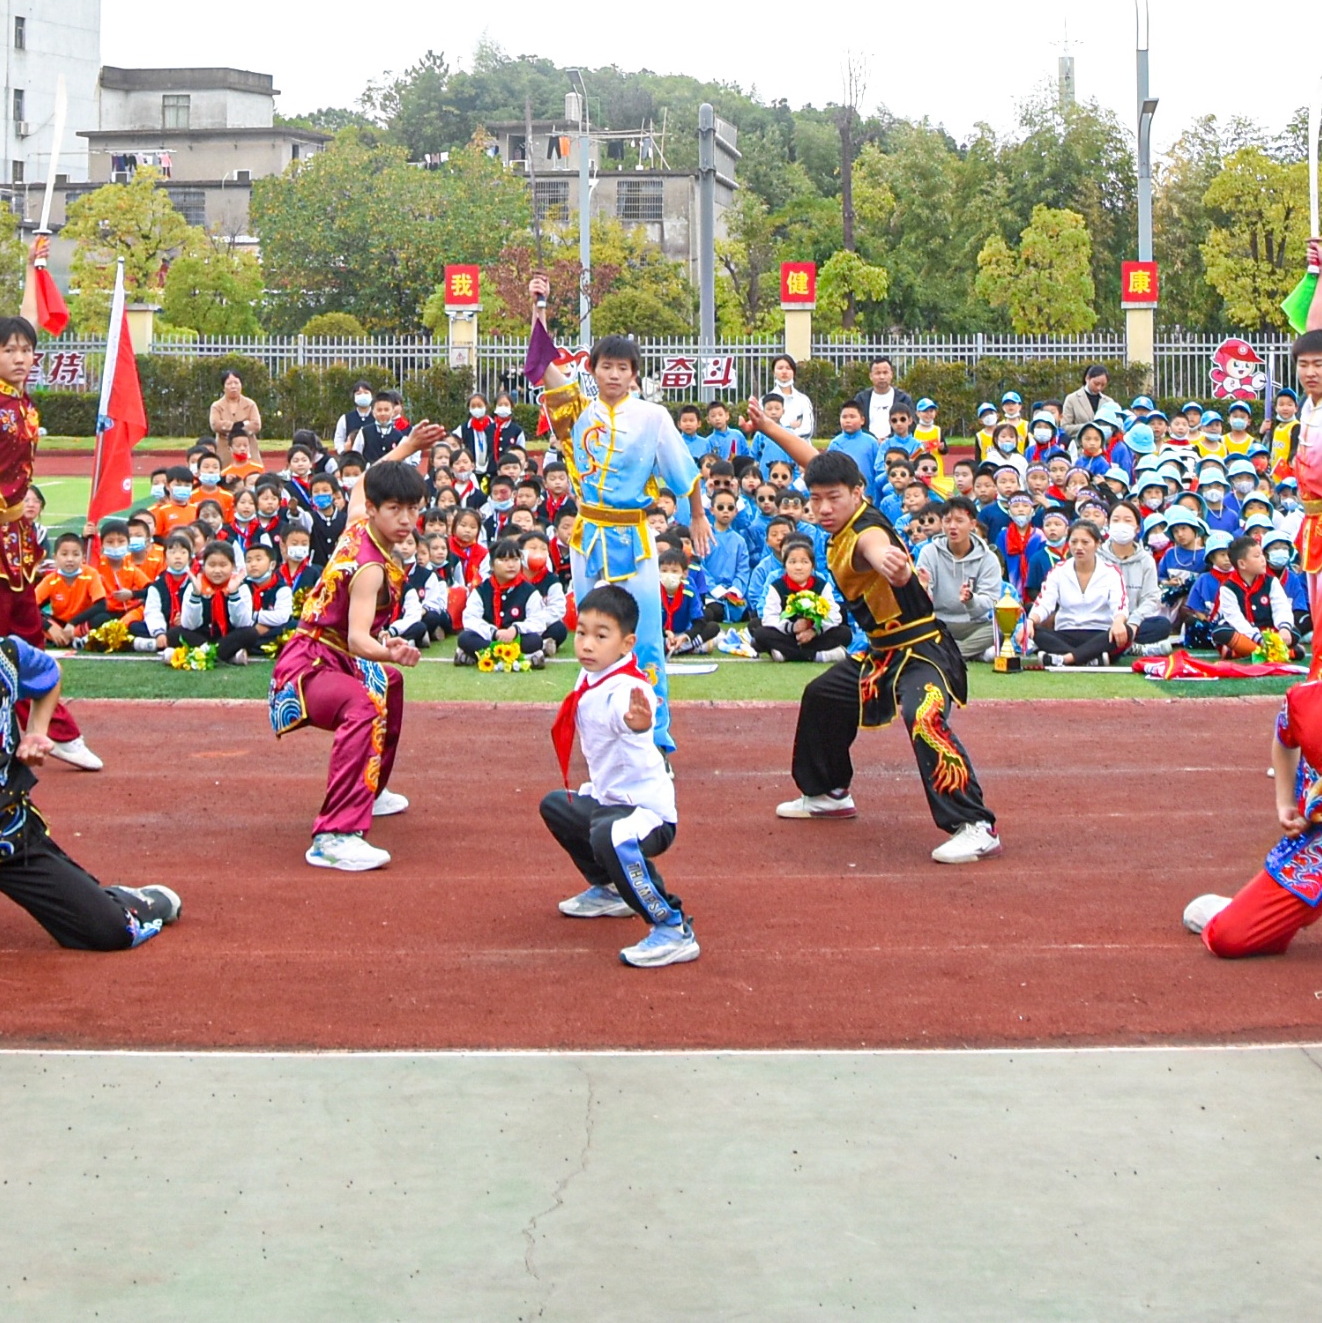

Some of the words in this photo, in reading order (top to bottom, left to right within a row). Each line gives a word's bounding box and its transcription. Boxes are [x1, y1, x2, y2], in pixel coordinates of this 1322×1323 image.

[451, 273, 473, 296] 我
[787, 271, 809, 294] 健
[1129, 270, 1151, 294] 康
[662, 357, 734, 388] 奋斗
